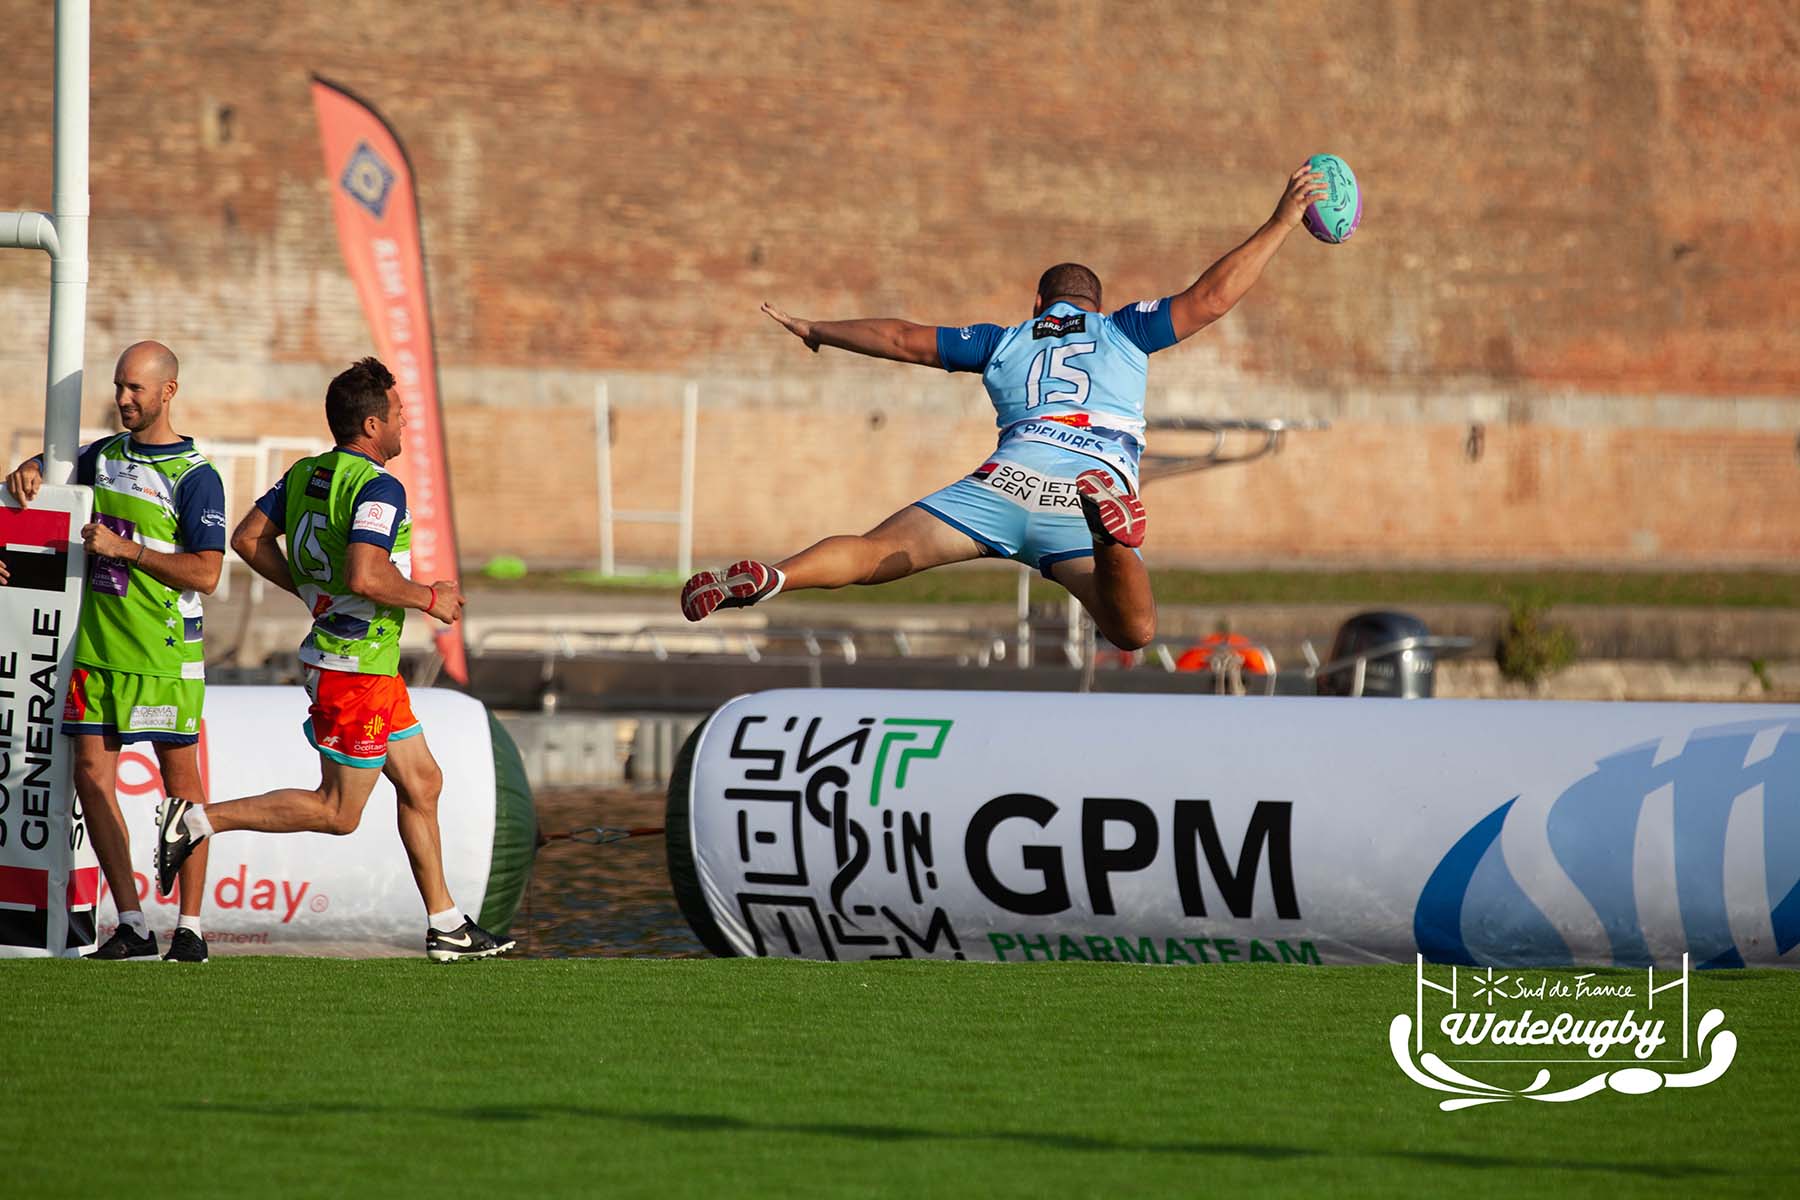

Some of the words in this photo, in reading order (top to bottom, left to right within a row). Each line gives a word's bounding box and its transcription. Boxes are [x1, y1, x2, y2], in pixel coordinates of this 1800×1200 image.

[1025, 341, 1097, 411] 15
[991, 477, 1083, 509] GENERA
[292, 510, 333, 584] 15
[21, 608, 61, 851] GENERALE
[965, 793, 1302, 920] GPM
[214, 864, 310, 923] day
[987, 932, 1323, 965] PHARMATEAM
